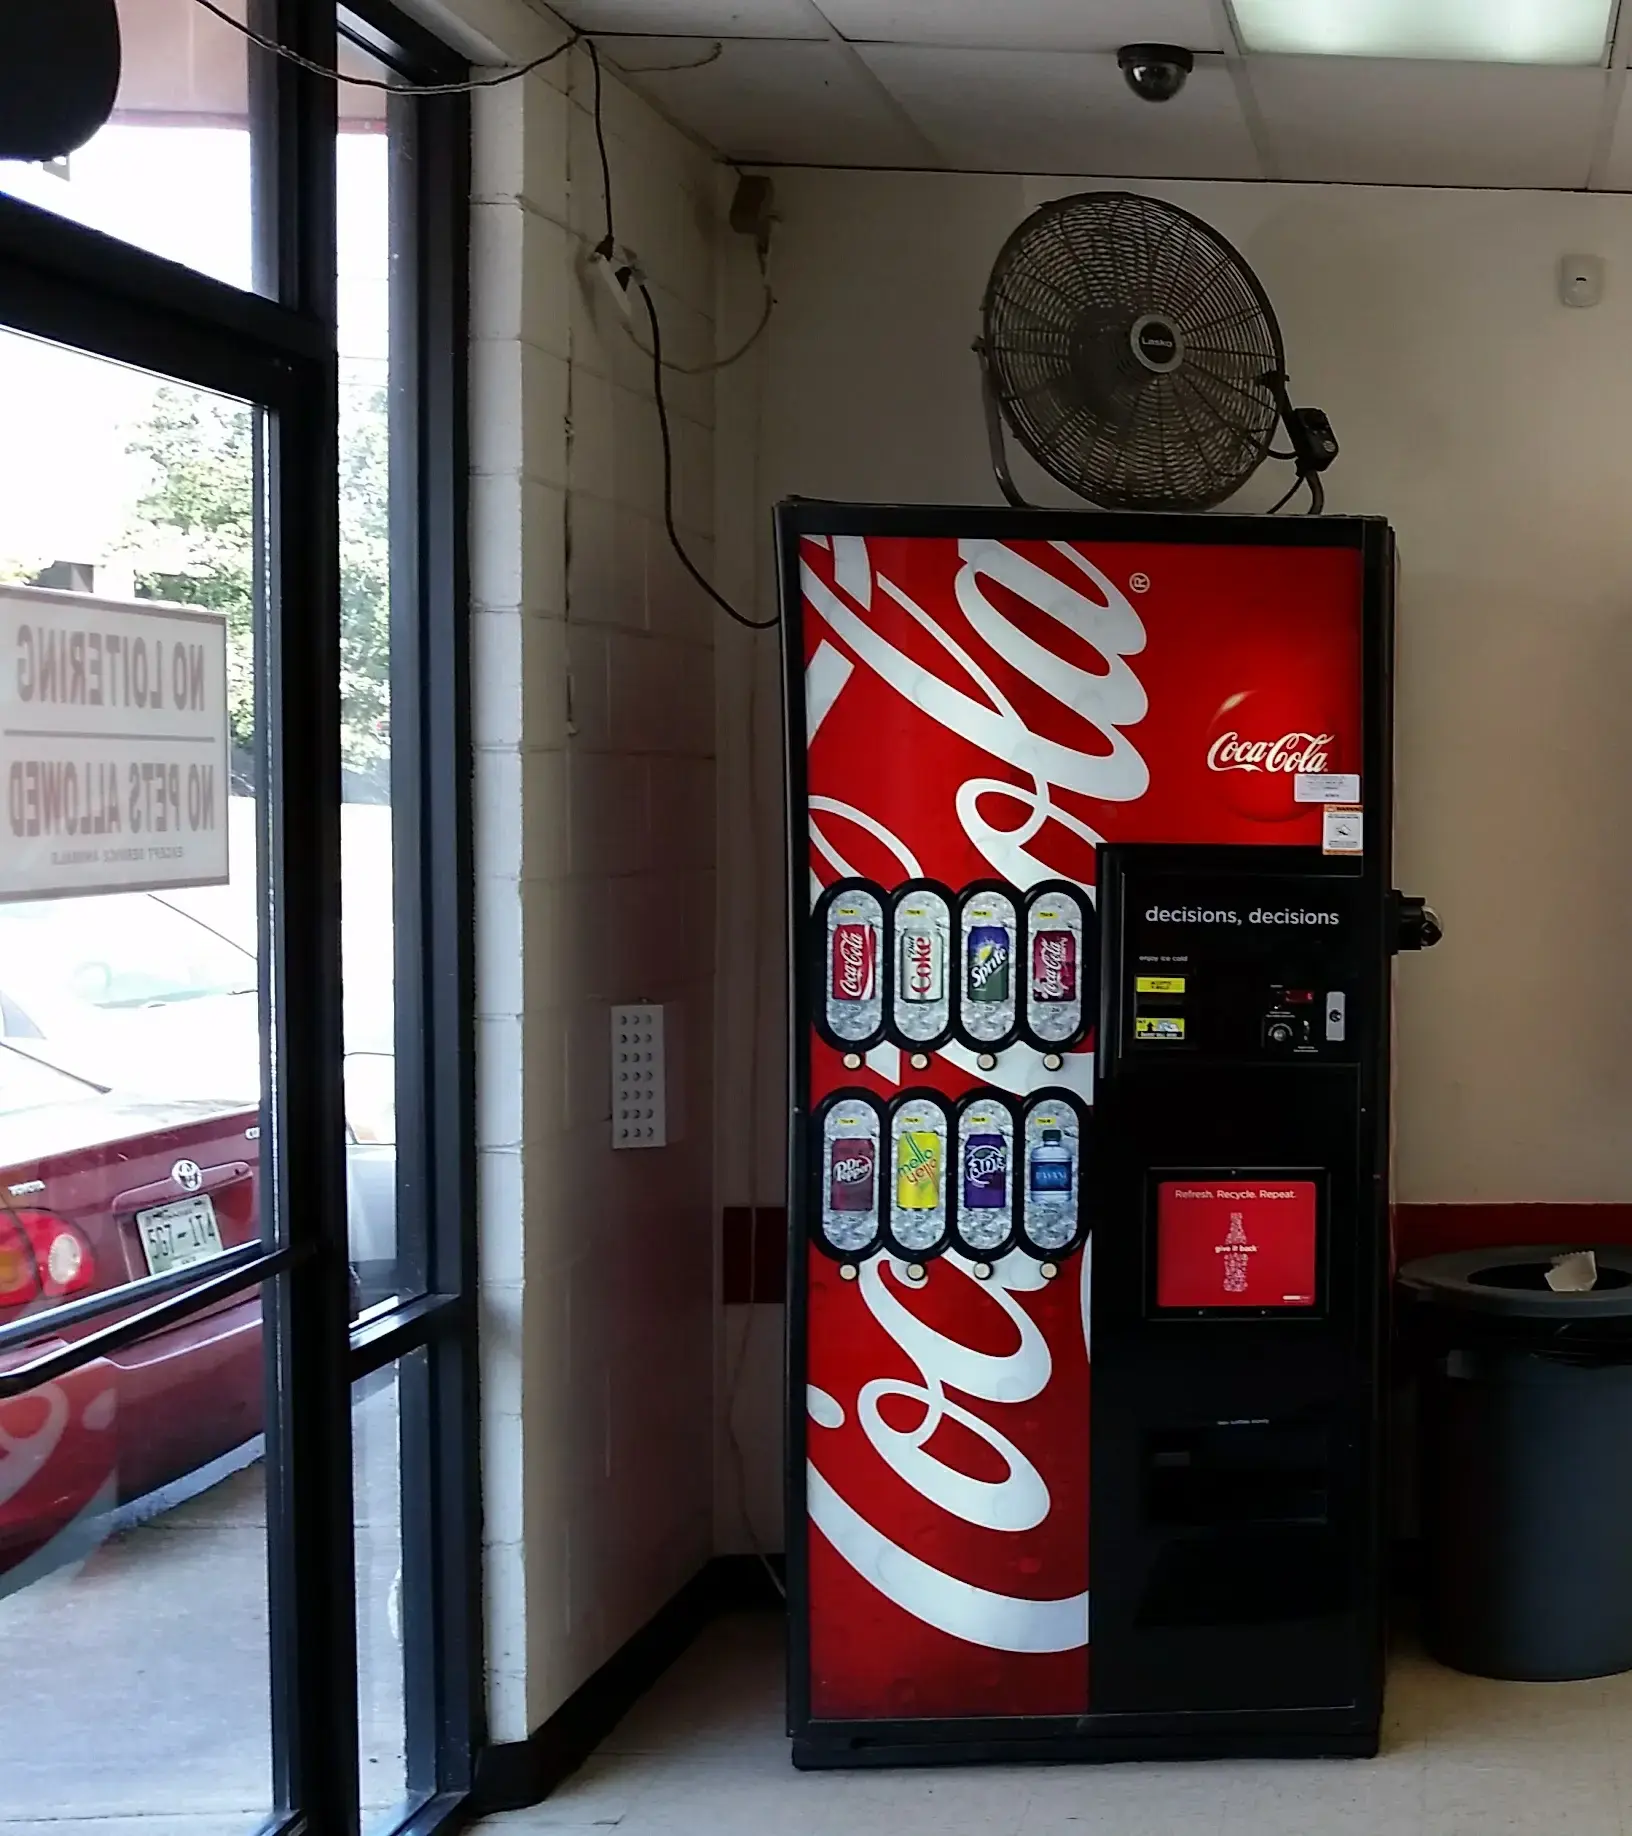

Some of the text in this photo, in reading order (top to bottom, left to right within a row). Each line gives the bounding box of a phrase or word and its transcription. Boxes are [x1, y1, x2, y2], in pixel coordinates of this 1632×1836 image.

[1207, 731, 1335, 773] Coca-Cola
[1145, 906, 1339, 926] decisions, decisions
[841, 929, 864, 997] Coca-Cola
[911, 937, 932, 993] Coke
[971, 947, 1007, 988] Sprite
[898, 1149, 933, 1177] mello
[906, 1158, 937, 1185] yello
[1175, 1190, 1296, 1200] Refresh. Recycle. Repeat.
